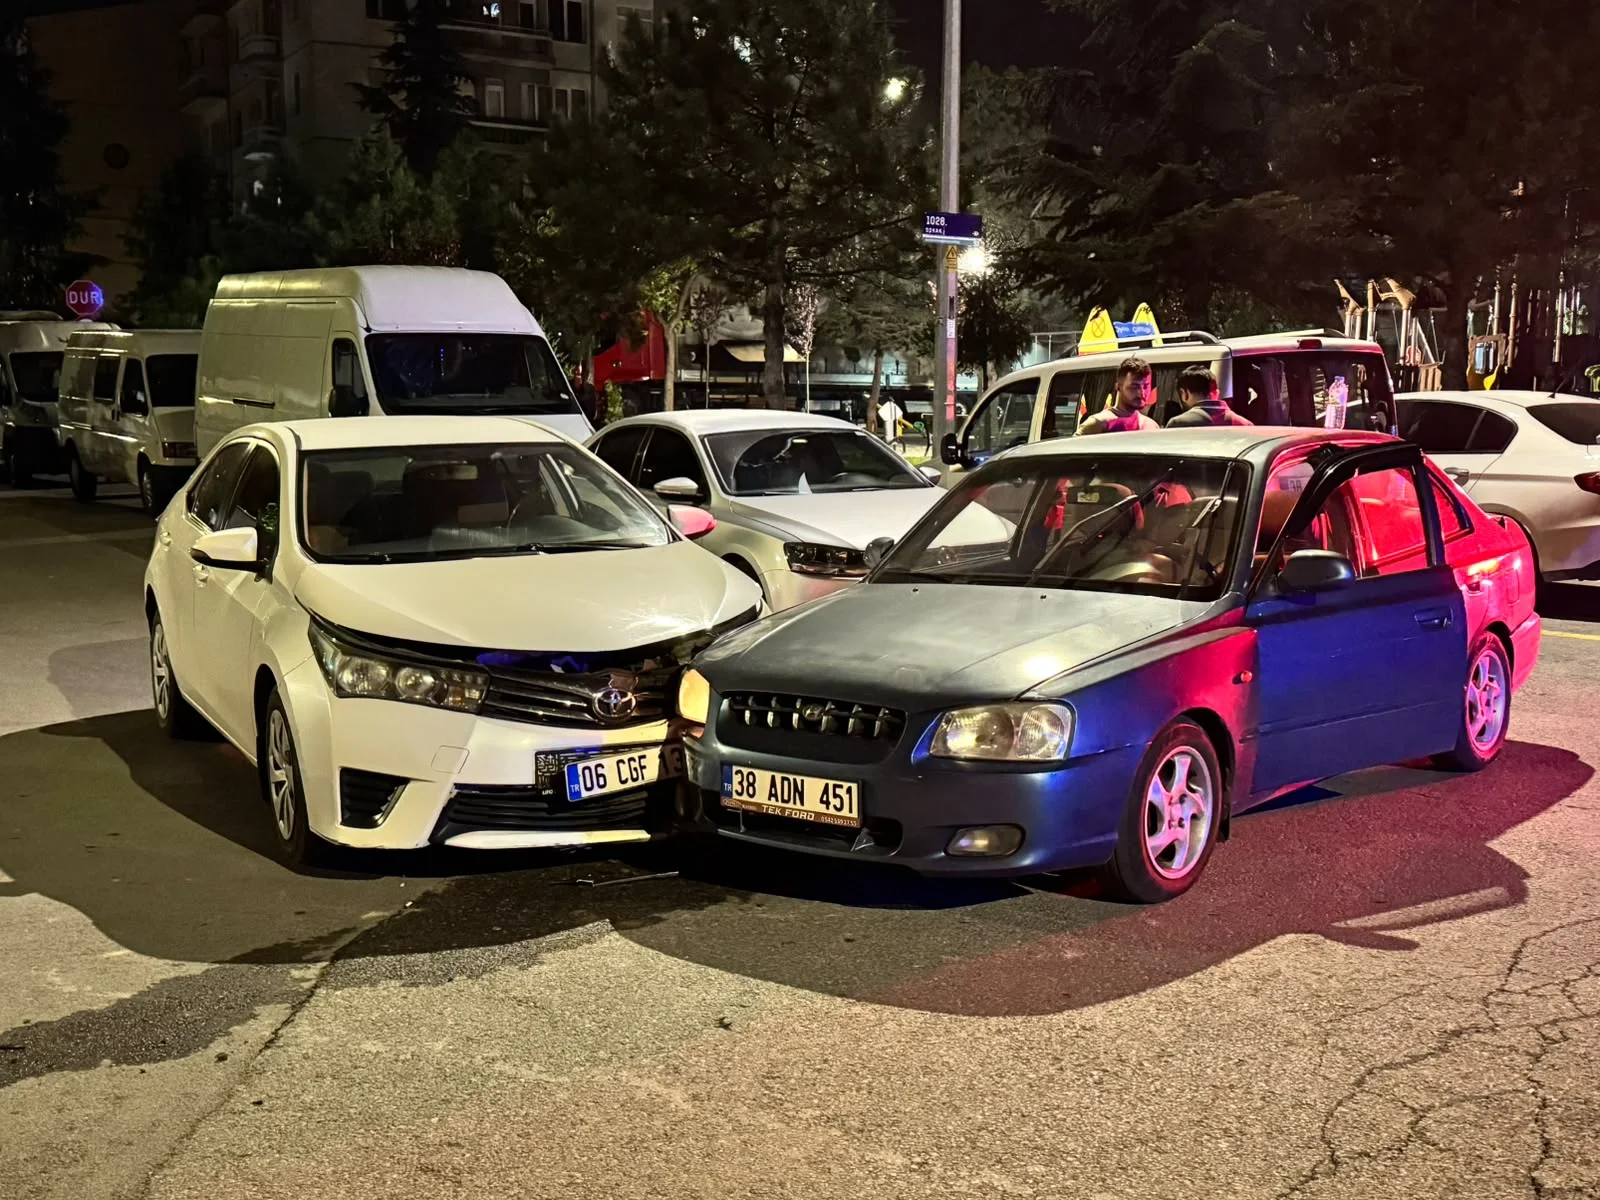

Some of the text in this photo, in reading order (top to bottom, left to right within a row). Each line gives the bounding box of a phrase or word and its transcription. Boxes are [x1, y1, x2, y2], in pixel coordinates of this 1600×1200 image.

[926, 215, 948, 226] 1028.
[69, 291, 101, 305] DUR
[570, 784, 580, 793] TR
[581, 763, 607, 792] 06
[616, 754, 647, 785] CGF
[723, 769, 853, 814] TR 38 ADN 451
[762, 804, 782, 816] TEK
[785, 809, 815, 821] FORD
